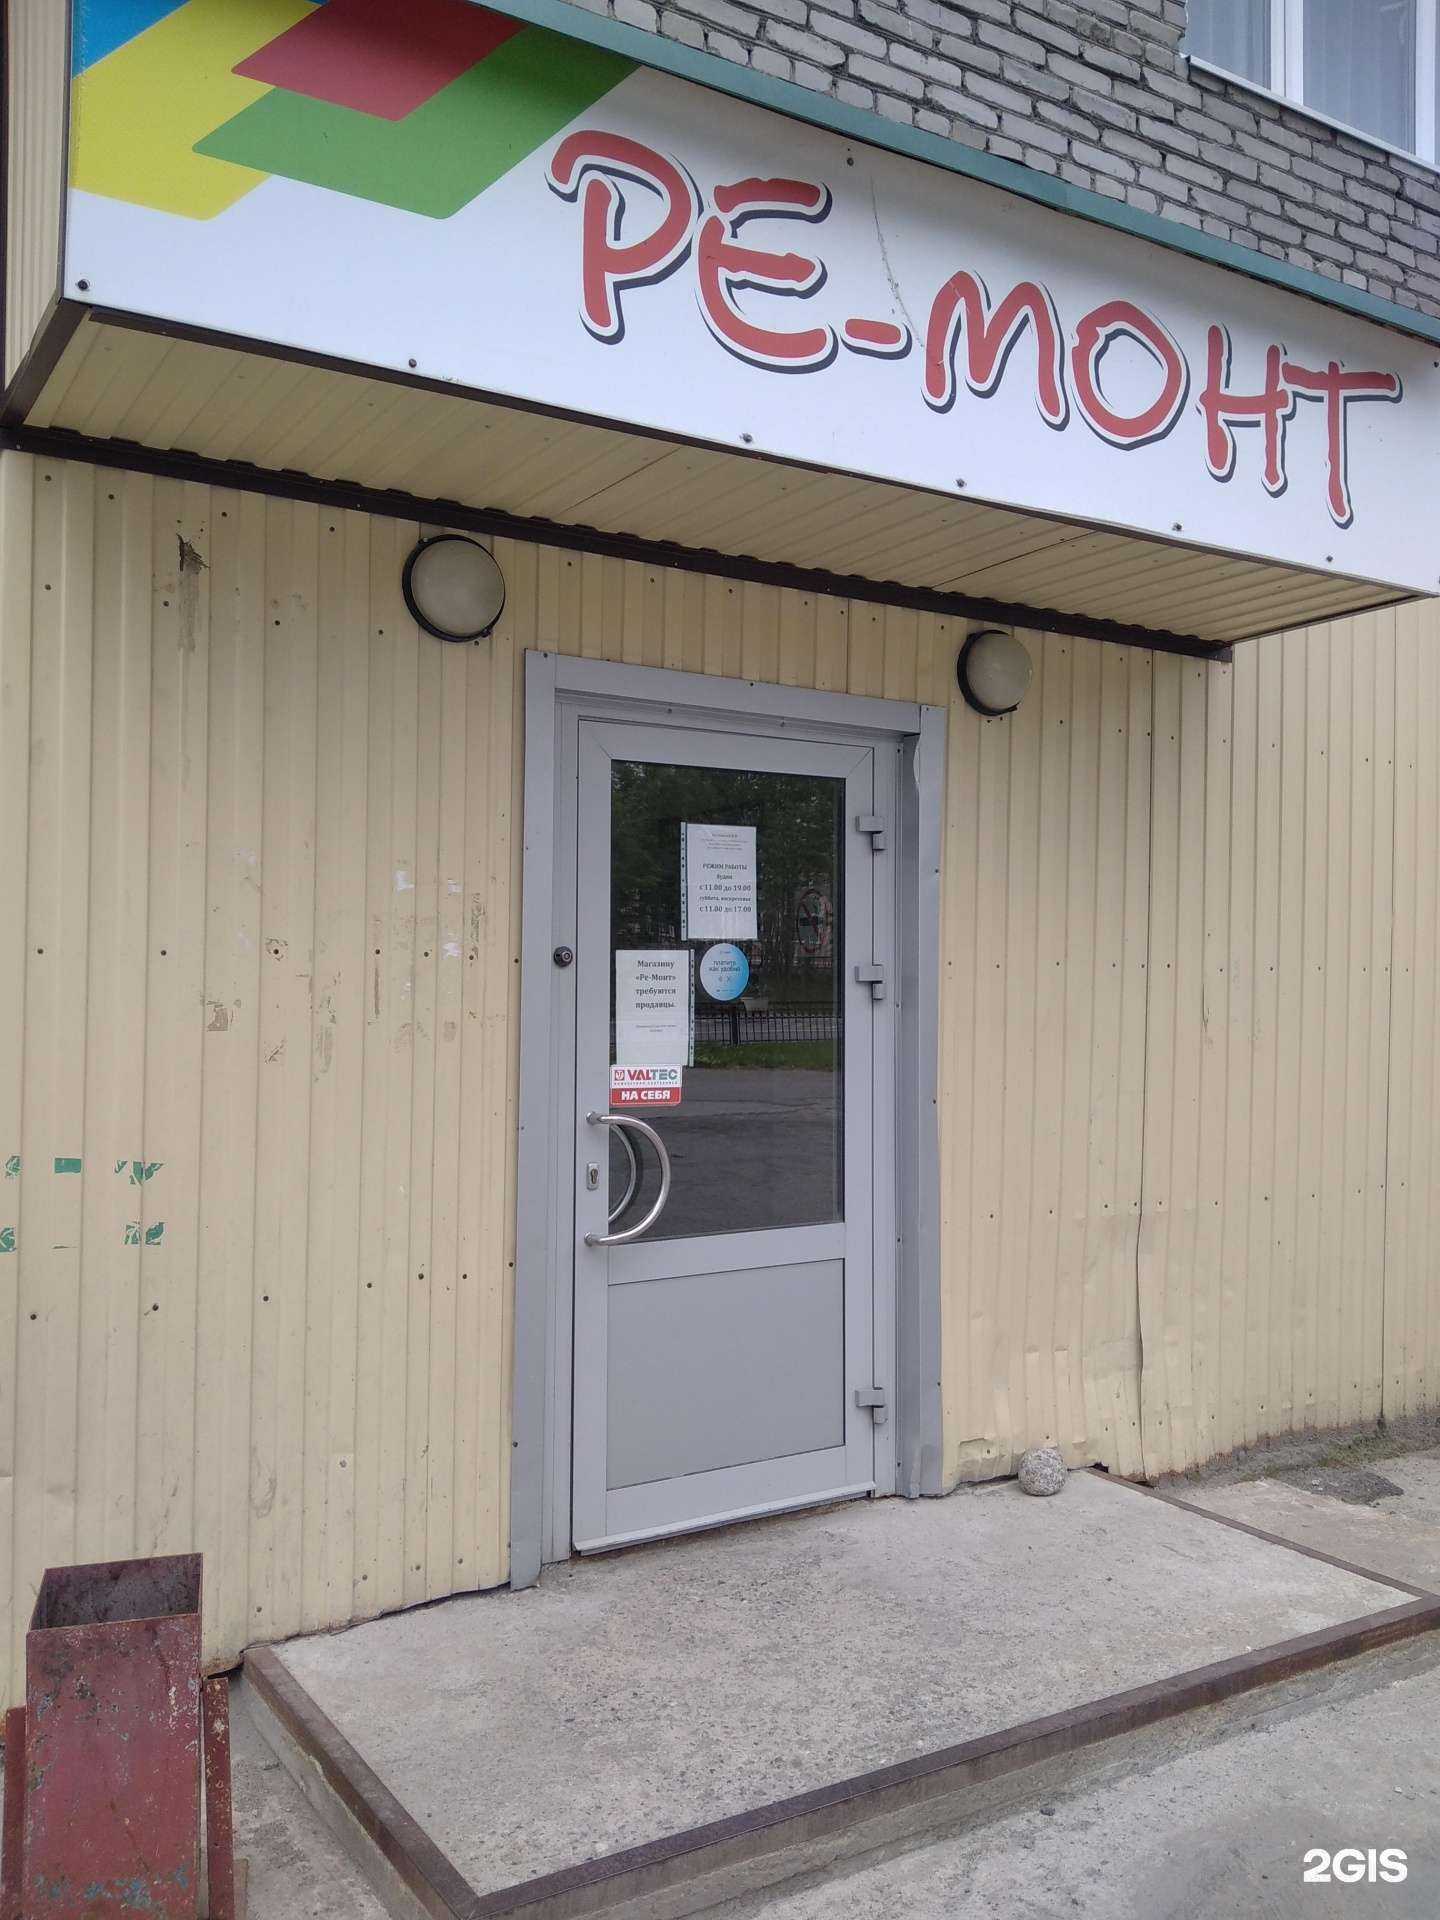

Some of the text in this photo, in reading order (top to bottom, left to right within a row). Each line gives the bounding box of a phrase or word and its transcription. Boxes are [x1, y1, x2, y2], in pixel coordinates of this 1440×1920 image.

[546, 130, 1402, 528] РЕ-МОНТ
[637, 960, 675, 969] Магазину
[635, 973, 677, 982] «Ре-Монт»
[635, 987, 676, 996] требуются
[627, 1069, 678, 1081] VALTEC
[621, 1090, 671, 1101] НА СЕБЯ
